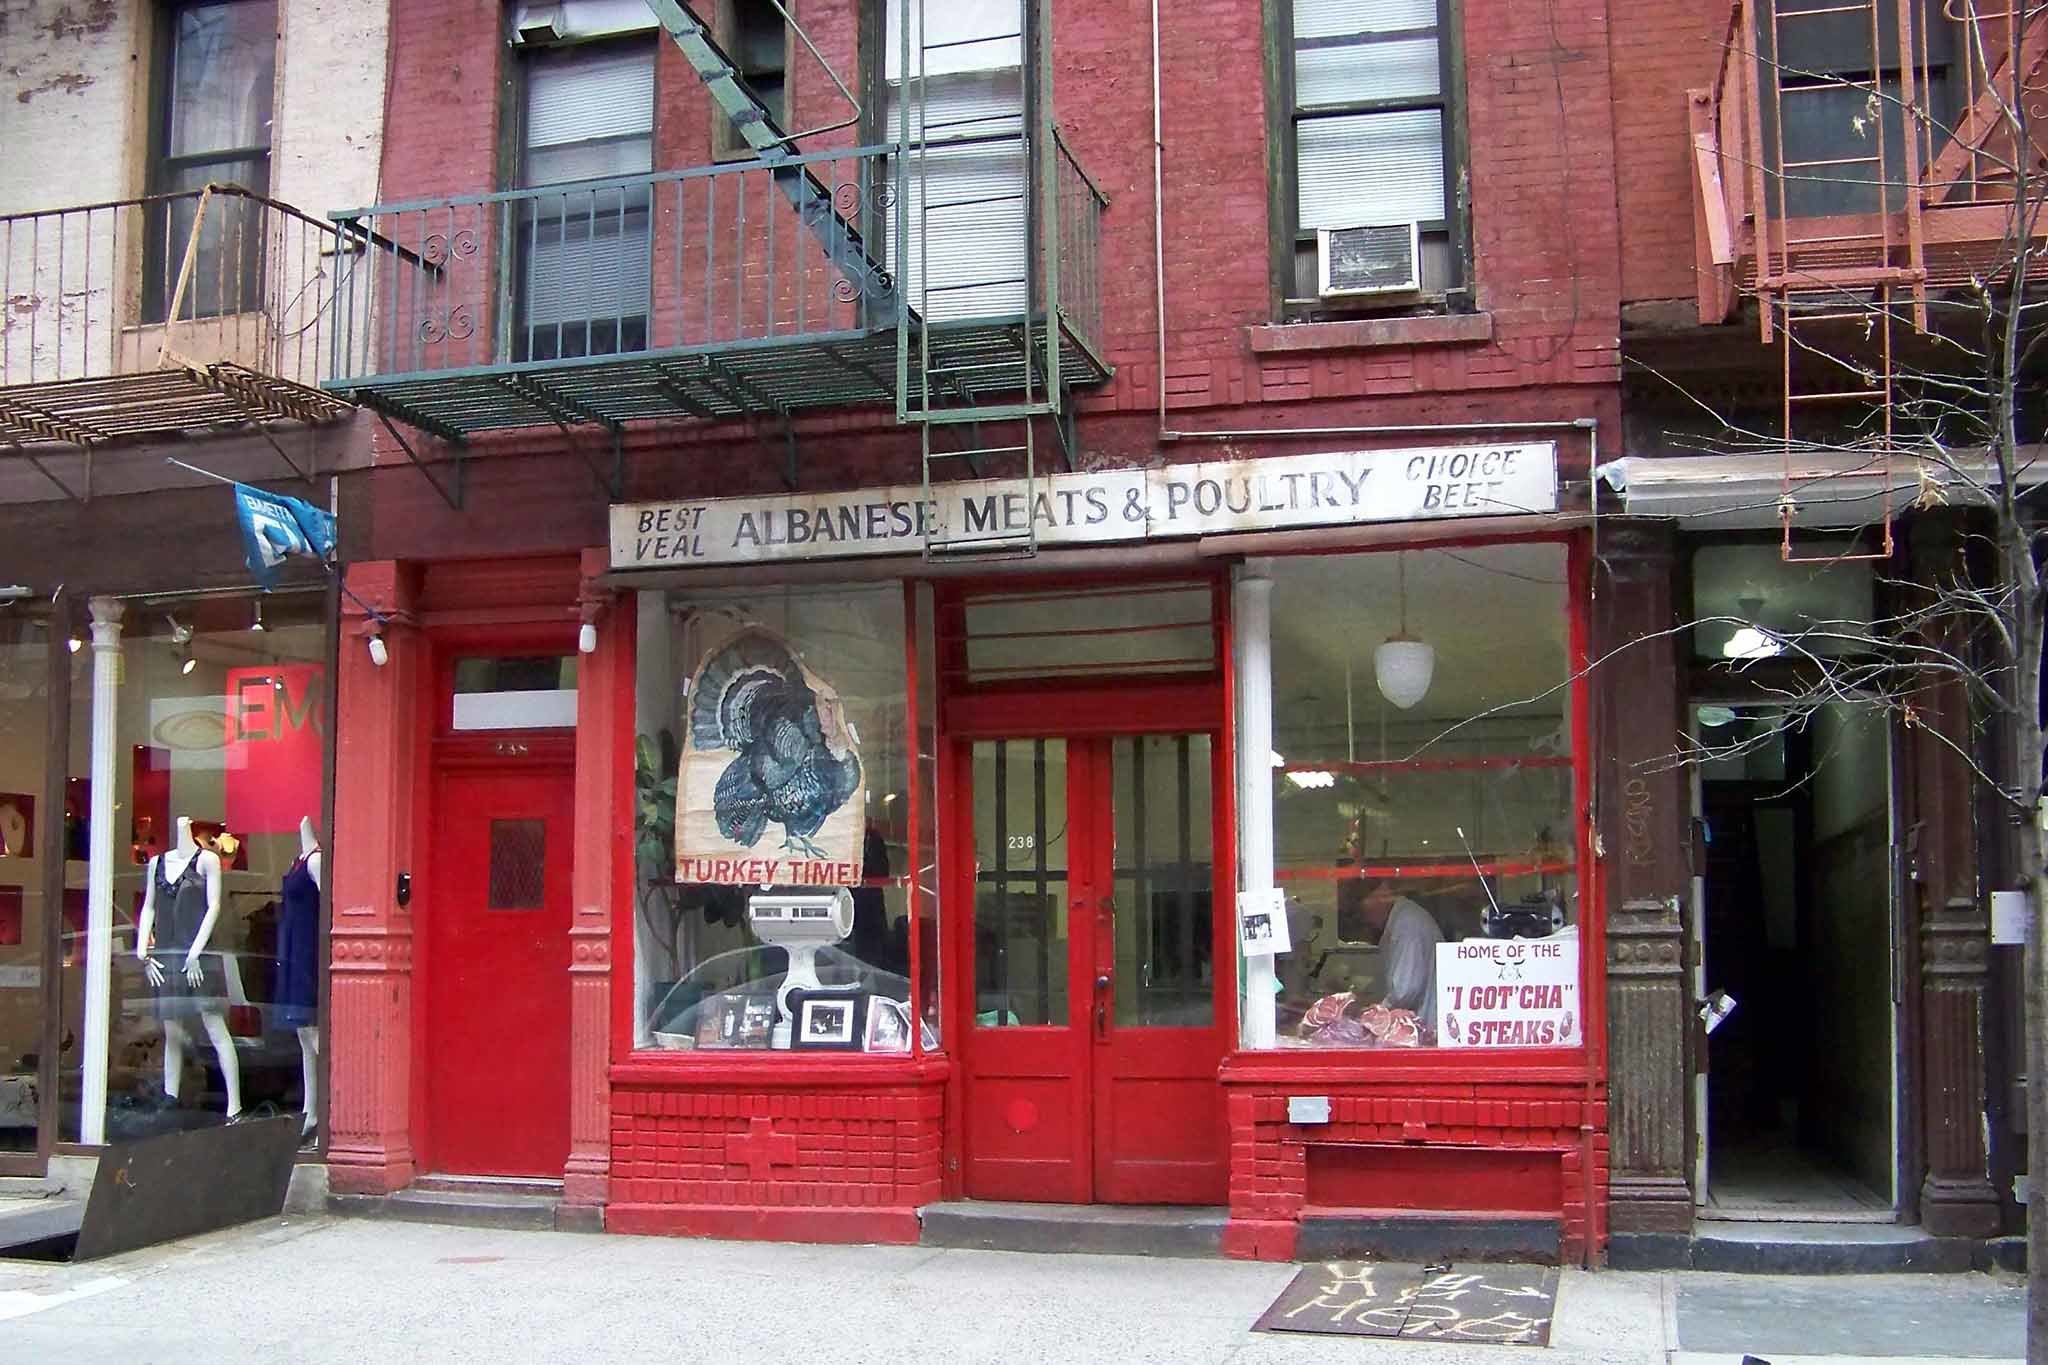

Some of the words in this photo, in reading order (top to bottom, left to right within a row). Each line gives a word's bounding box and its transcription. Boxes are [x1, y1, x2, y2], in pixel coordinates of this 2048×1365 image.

[1407, 449, 1522, 481] CHOICE
[731, 501, 938, 548] ALBANESE
[963, 488, 1107, 534] MEATS
[1121, 489, 1151, 522] &
[1167, 468, 1373, 520] POULTRY
[1423, 481, 1504, 510] BEEF
[638, 507, 706, 533] BEST
[635, 536, 705, 560] VEAL
[1008, 836, 1034, 849] 238
[680, 858, 779, 882] TURKEY
[788, 860, 863, 885] TIME!
[1457, 945, 1501, 959] HOME
[1506, 944, 1525, 958] OF
[1531, 943, 1562, 957] THE
[1467, 1020, 1555, 1045] STEAKS
